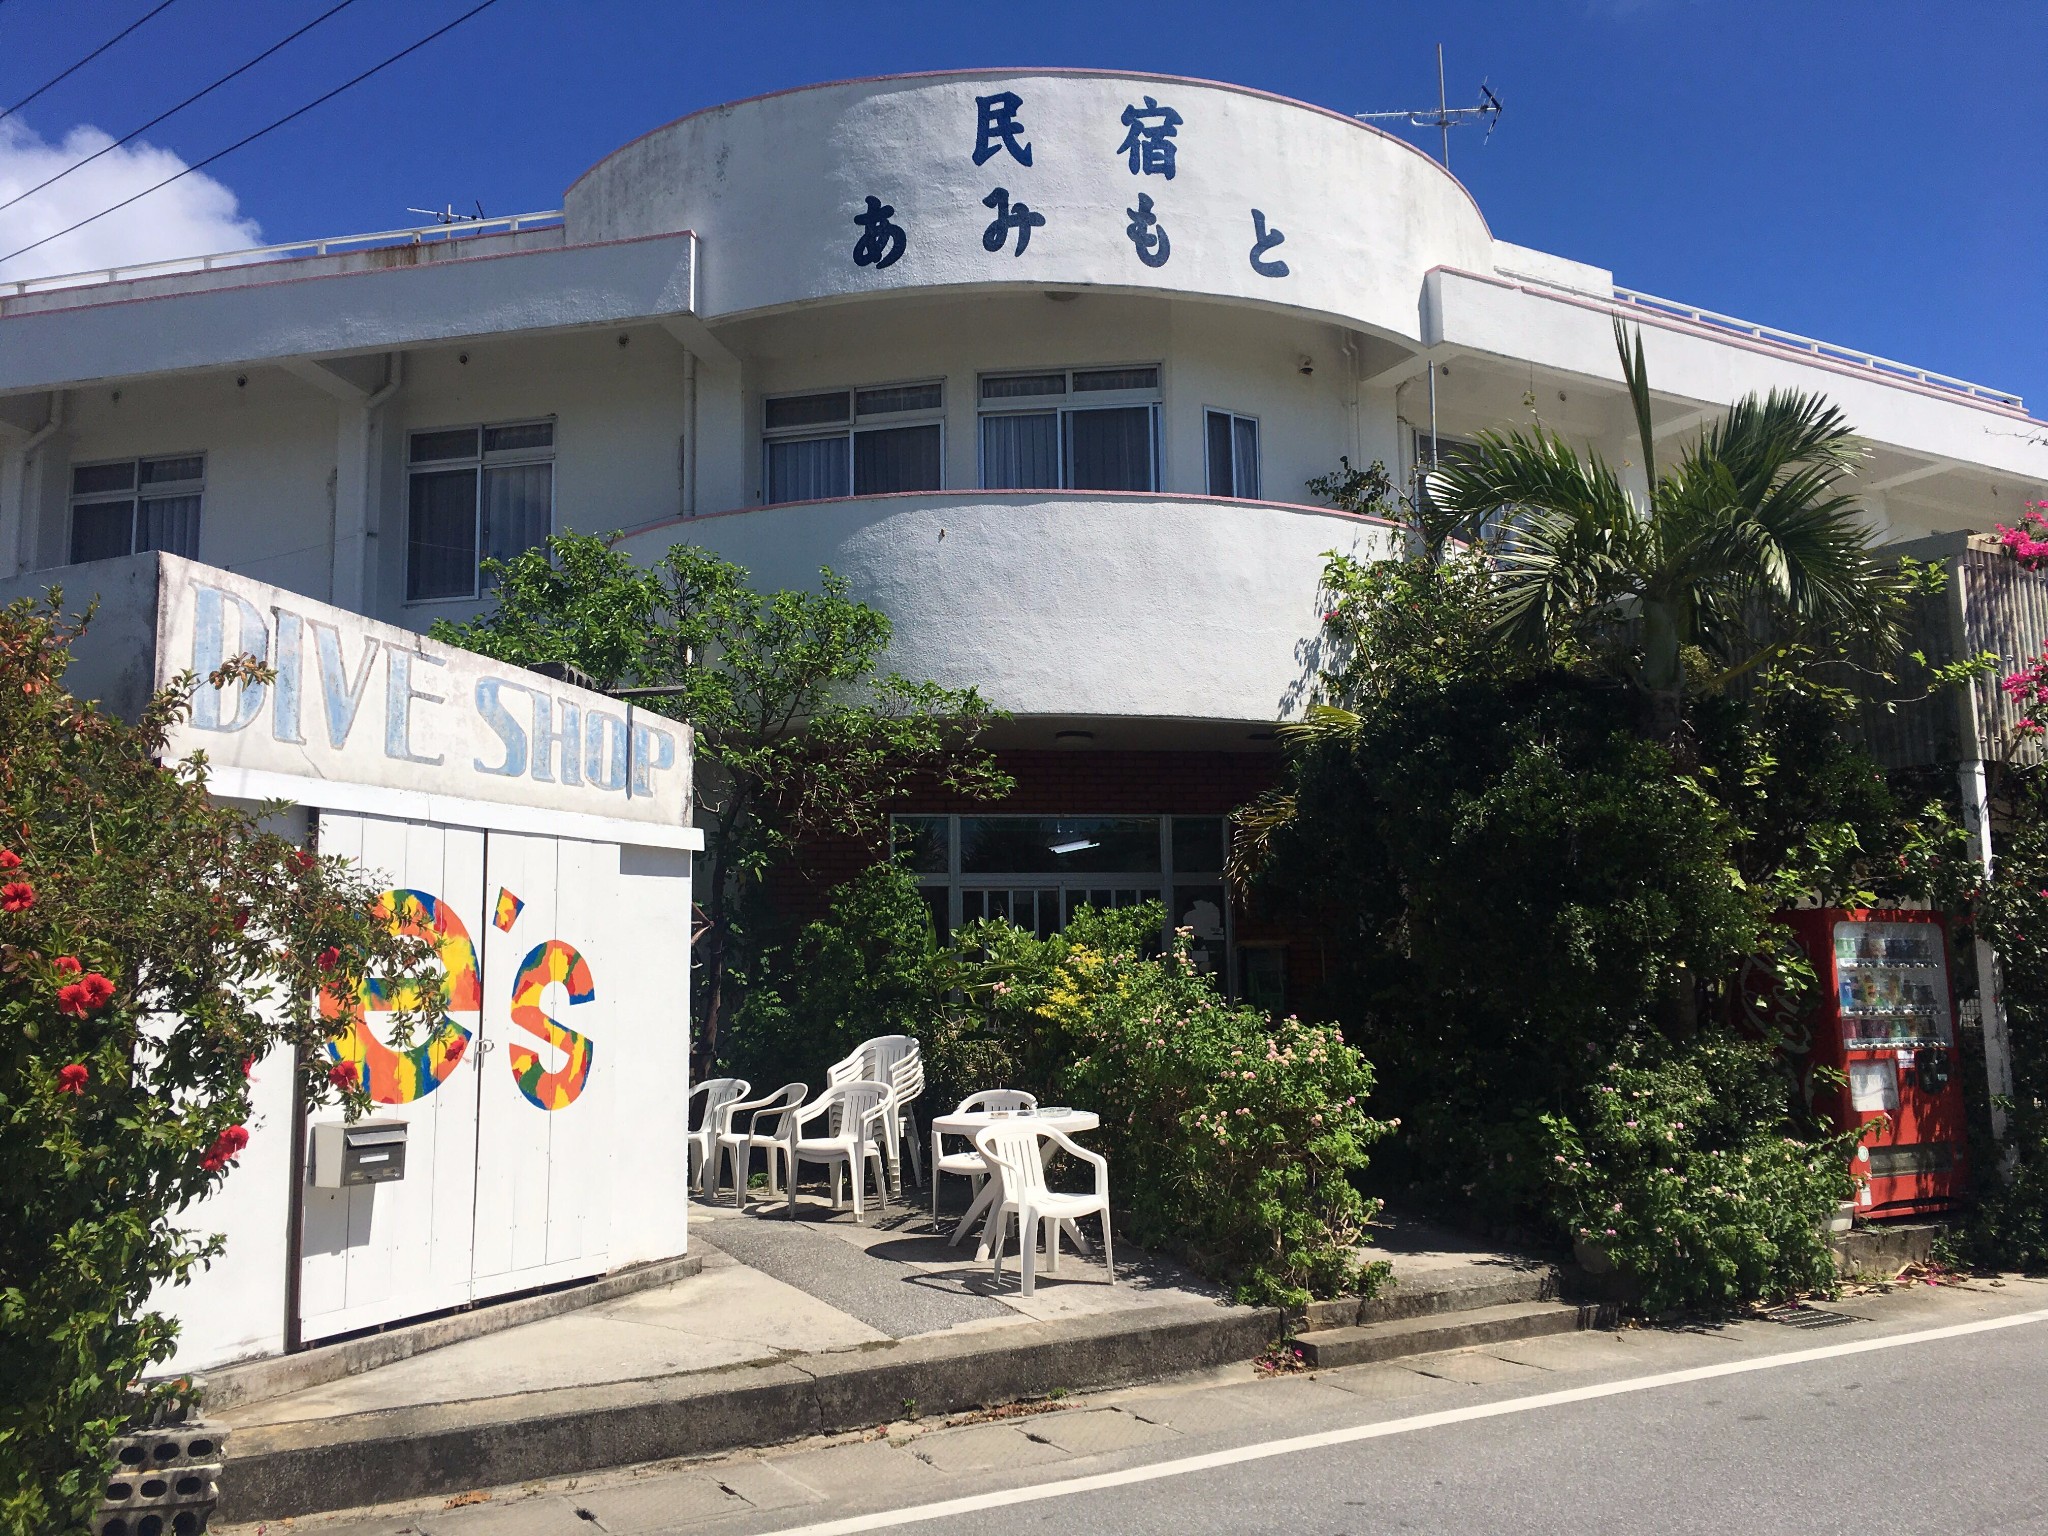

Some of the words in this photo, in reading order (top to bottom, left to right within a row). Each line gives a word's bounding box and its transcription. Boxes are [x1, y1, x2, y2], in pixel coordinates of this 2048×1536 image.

[972, 91, 1184, 180] 民宿
[852, 187, 1290, 278] あみもと
[188, 578, 446, 766] DIVE
[473, 676, 675, 798] SHOP
